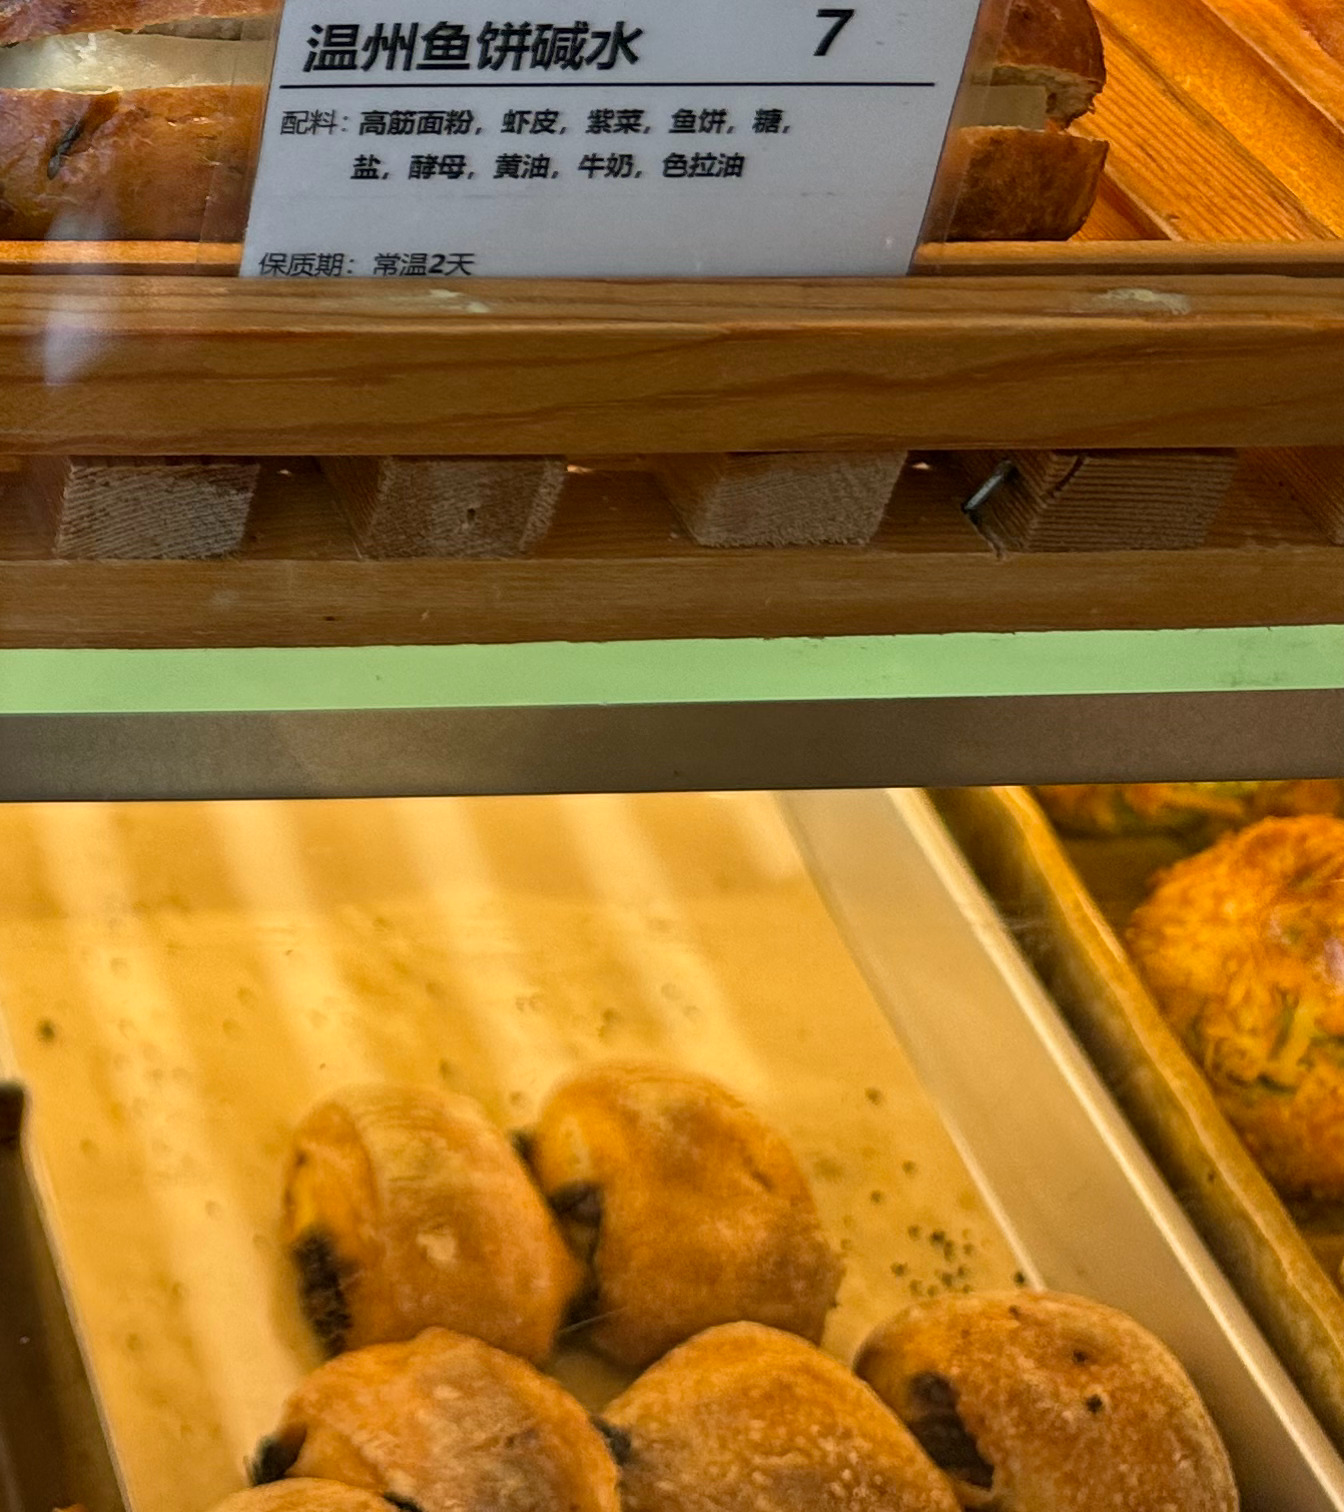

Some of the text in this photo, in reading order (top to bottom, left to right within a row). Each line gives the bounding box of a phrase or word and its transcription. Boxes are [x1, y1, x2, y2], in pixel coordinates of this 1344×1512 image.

[304, 21, 641, 72] 温州鱼饼碱水
[813, 8, 856, 56] 7
